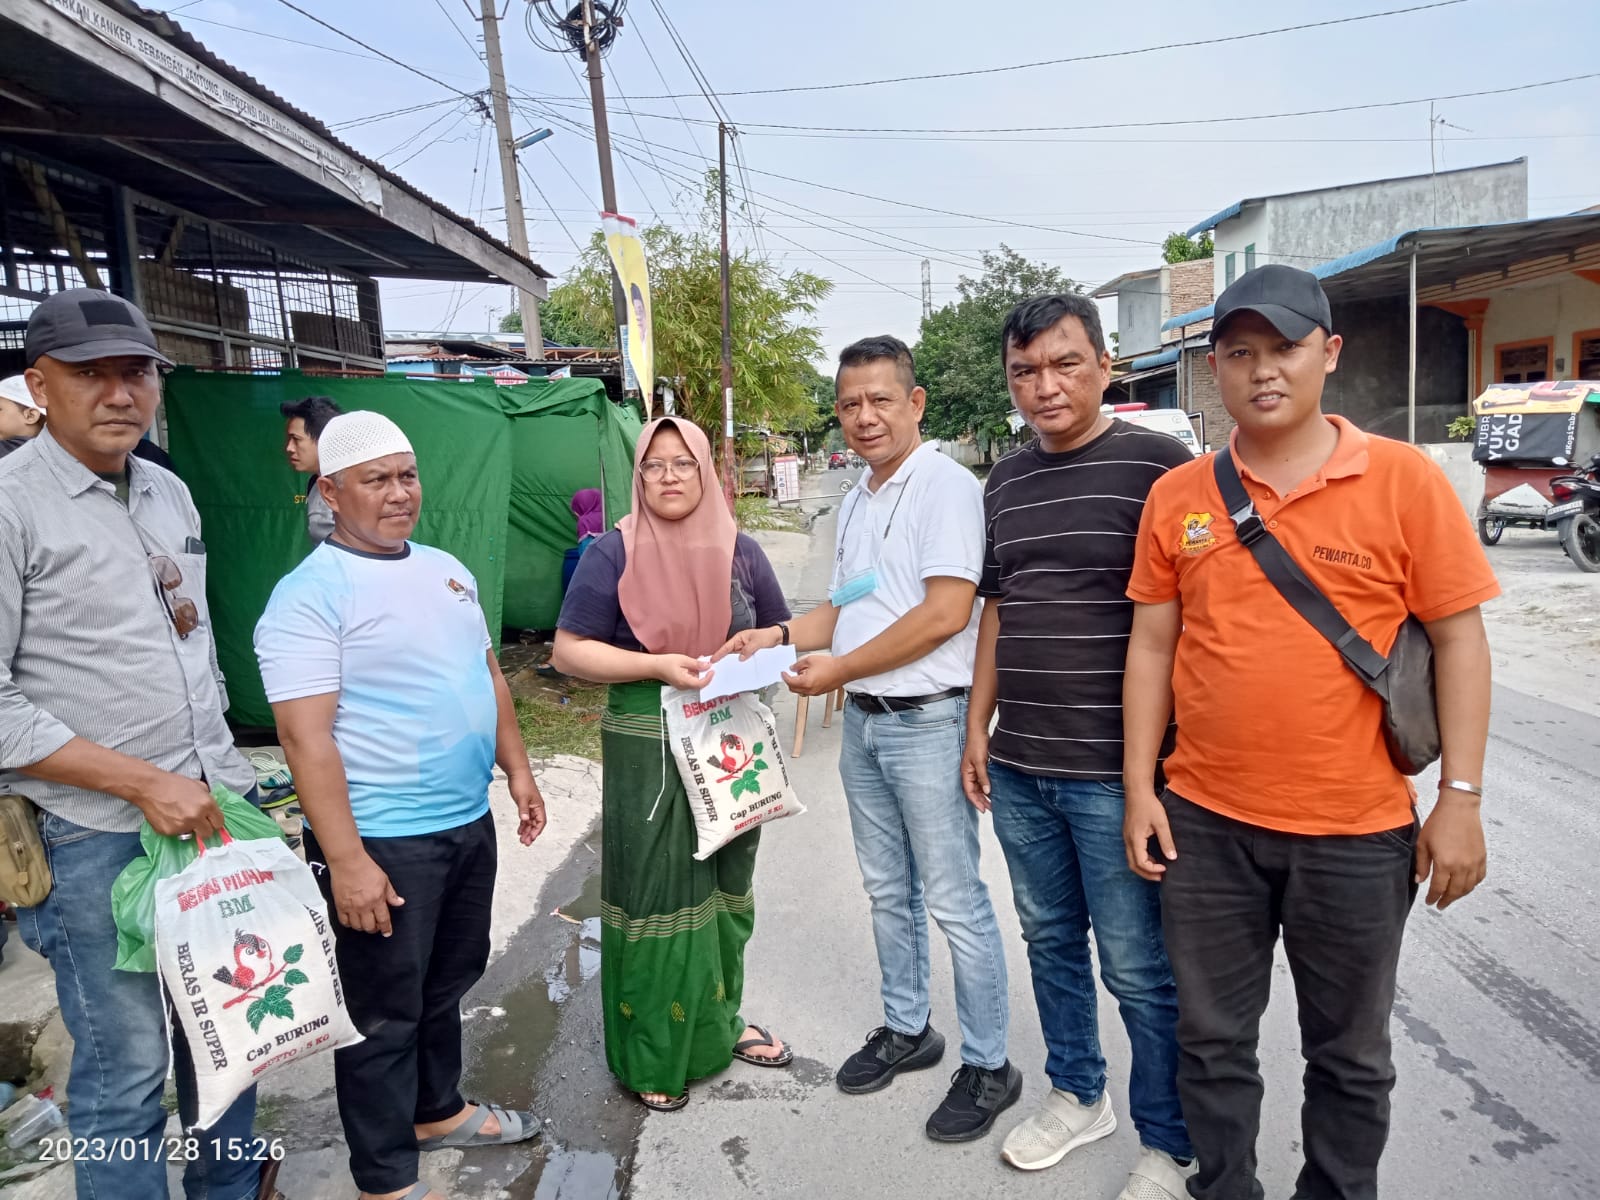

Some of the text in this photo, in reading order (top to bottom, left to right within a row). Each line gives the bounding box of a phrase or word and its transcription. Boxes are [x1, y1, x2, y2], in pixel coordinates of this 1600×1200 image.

[1488, 423, 1506, 461] YUK
[1312, 545, 1373, 570] PEWARTA.CO
[709, 706, 733, 726] BM
[680, 736, 700, 772] BERAS
[699, 787, 718, 822] SUPER
[730, 791, 782, 820] Cap BURUNG
[217, 893, 255, 918] BM
[176, 941, 228, 1071] BERAS IR SUPER
[246, 1015, 329, 1062] Cap BURUNG
